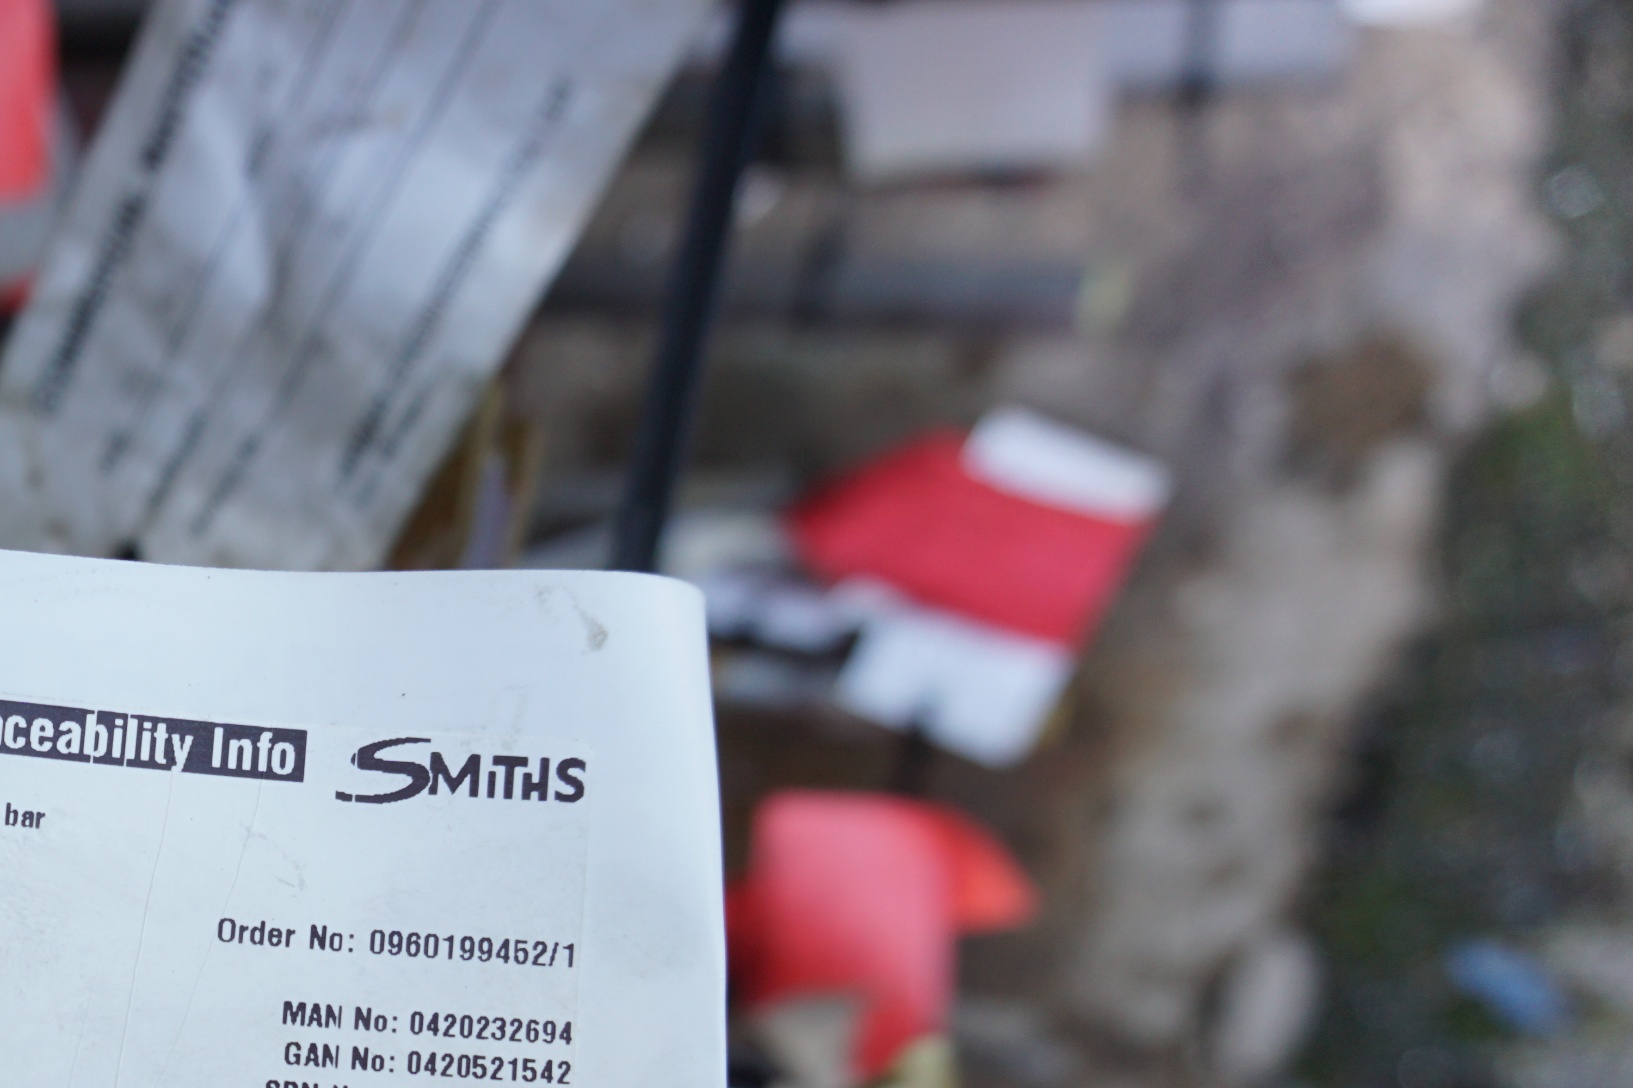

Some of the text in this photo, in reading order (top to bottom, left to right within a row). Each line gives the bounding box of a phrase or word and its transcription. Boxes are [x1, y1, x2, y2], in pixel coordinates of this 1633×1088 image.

[211, 726, 297, 776] Info
[335, 737, 586, 804] SMITHS
[5, 802, 46, 829] bar
[218, 918, 574, 968] Order No: 0960199452/1
[282, 1001, 572, 1045] MAN No: 0420232694
[284, 1042, 571, 1084] GAN No: 0420521542
